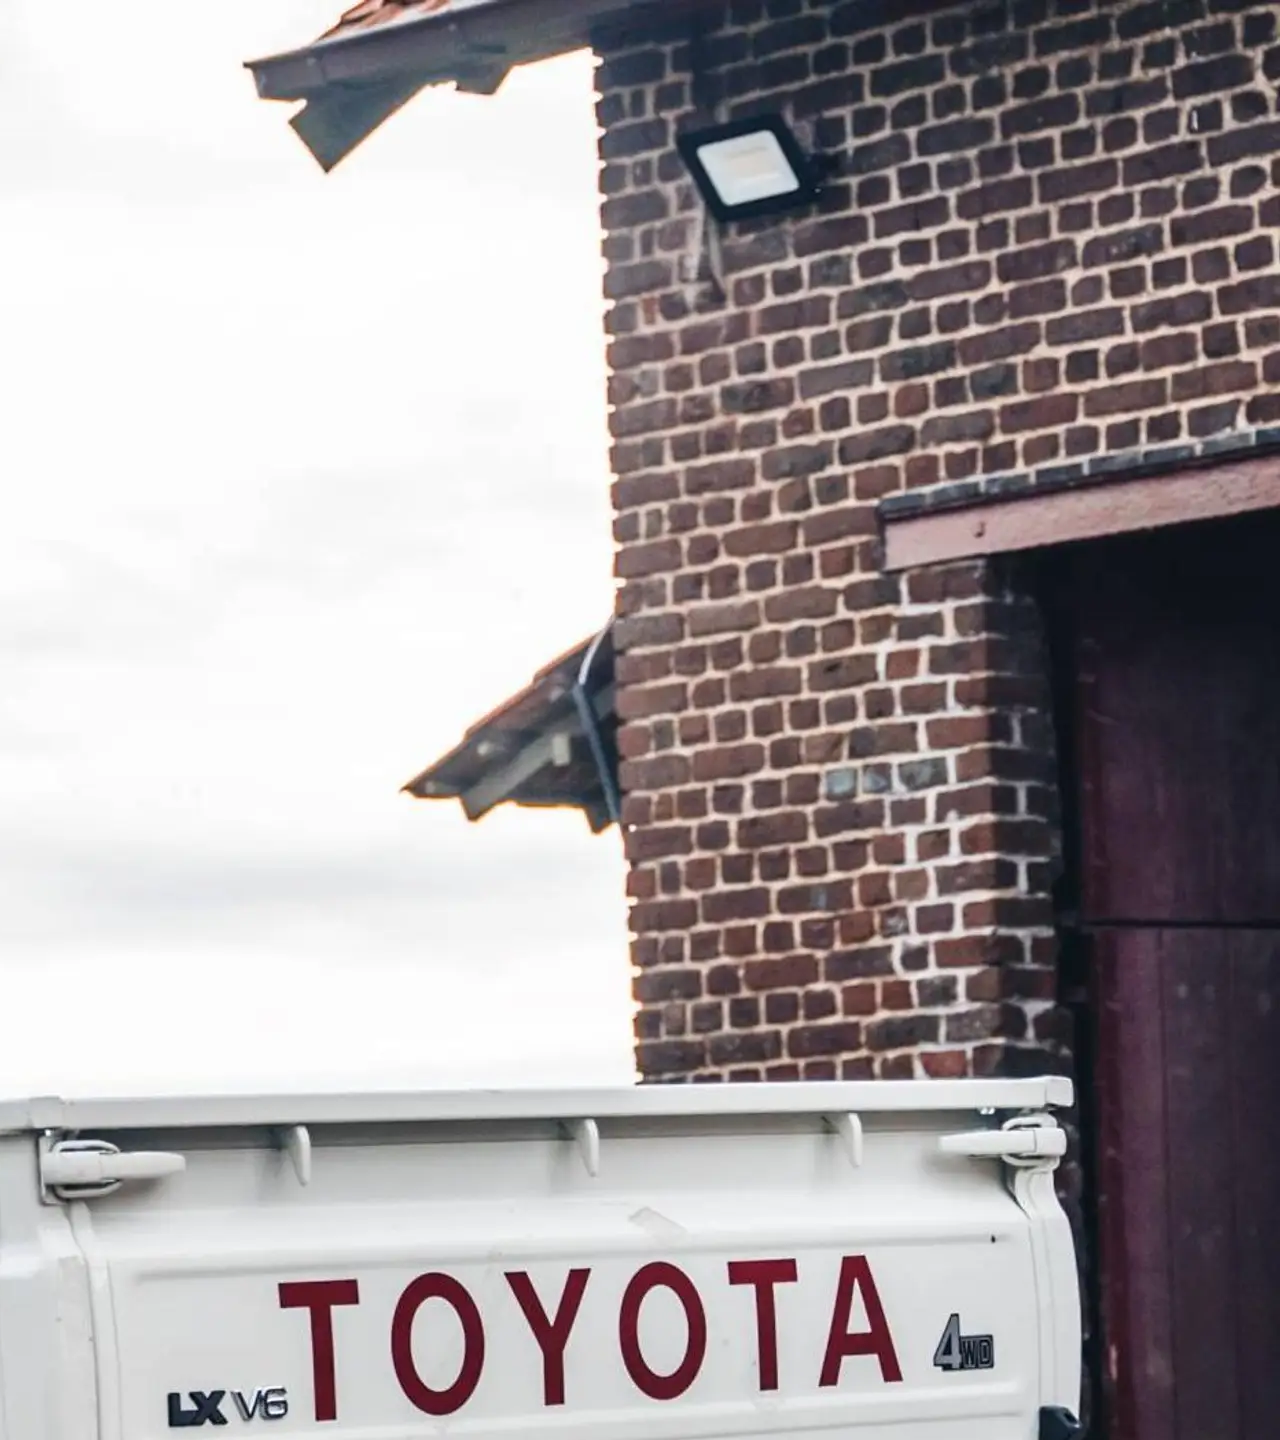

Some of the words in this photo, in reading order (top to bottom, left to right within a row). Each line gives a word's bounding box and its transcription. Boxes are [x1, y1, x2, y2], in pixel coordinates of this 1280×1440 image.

[278, 1254, 904, 1423] TOYOTA
[933, 1313, 994, 1371] 4WD
[167, 1389, 229, 1428] LX
[229, 1385, 289, 1423] V6
